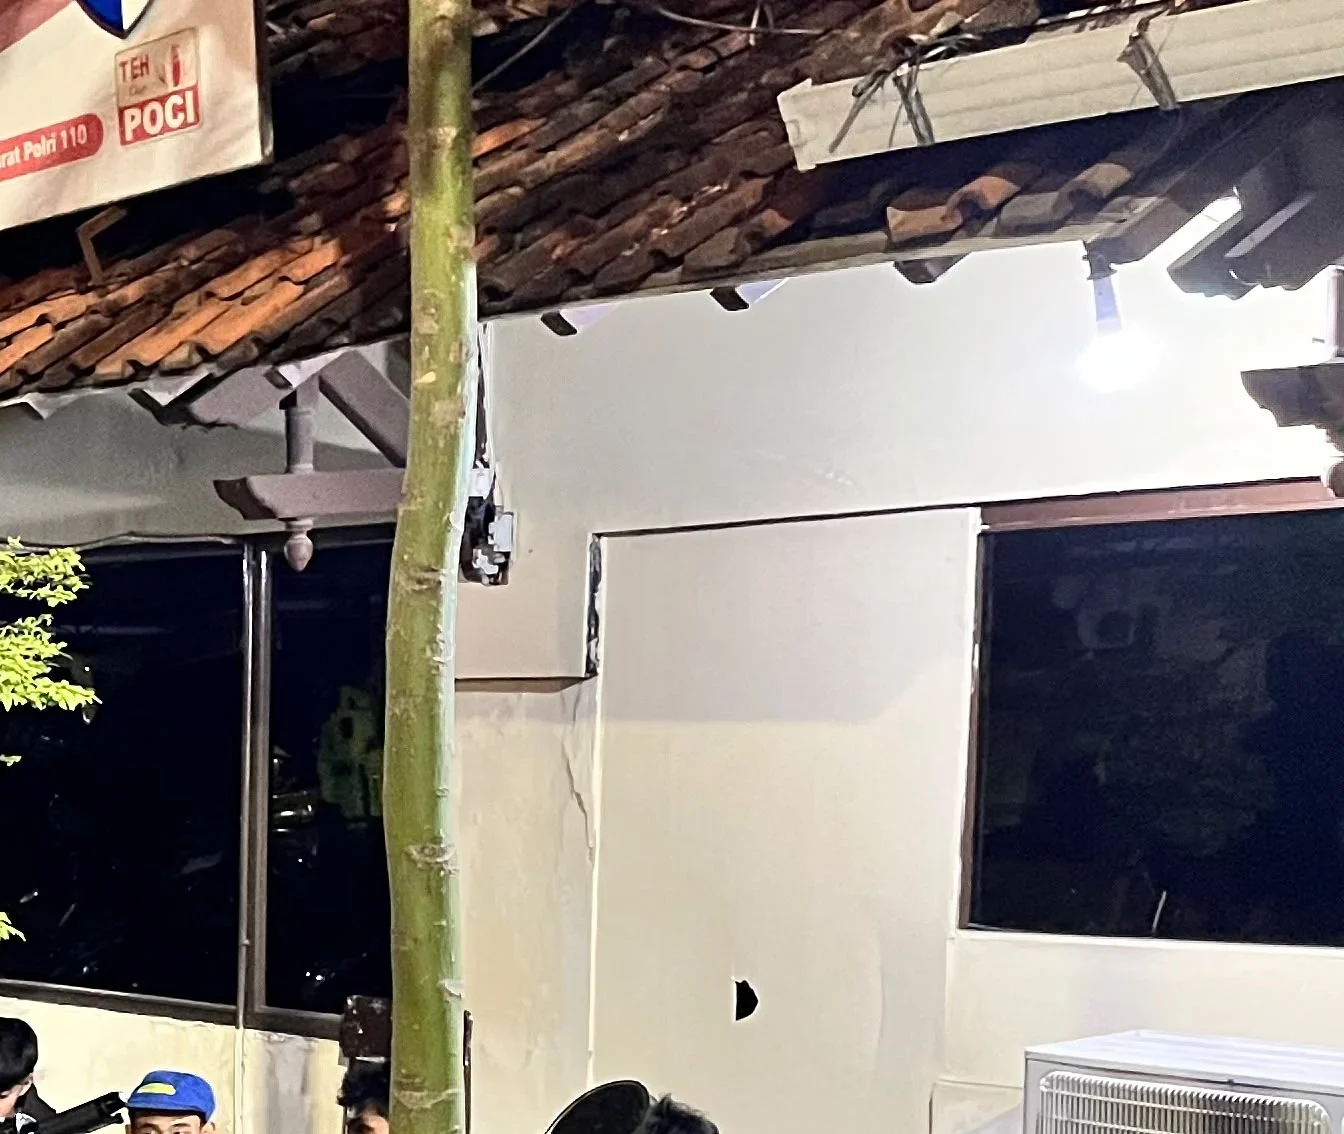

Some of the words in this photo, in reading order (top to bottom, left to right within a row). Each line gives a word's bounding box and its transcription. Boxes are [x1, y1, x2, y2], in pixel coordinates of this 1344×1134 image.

[119, 54, 150, 83] TEH
[123, 90, 195, 141] POCI
[24, 134, 57, 161] Polri
[61, 123, 88, 149] 110
